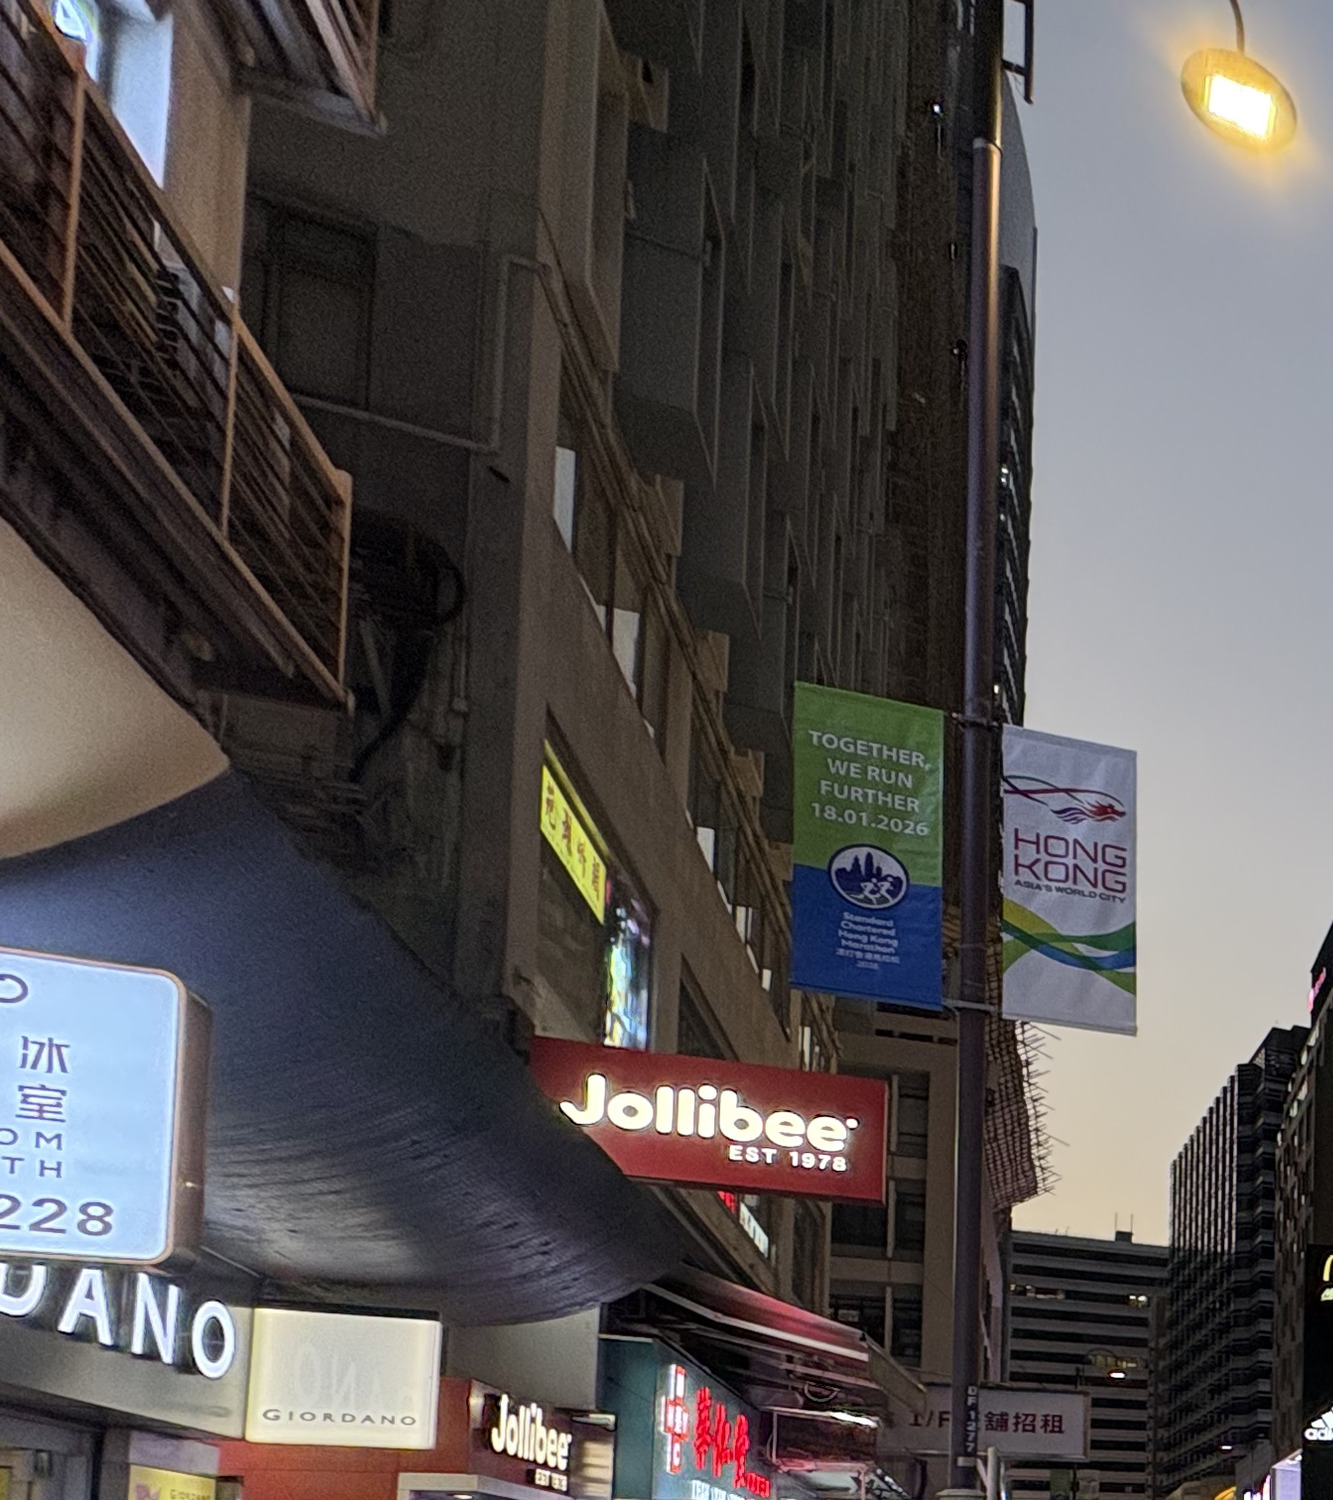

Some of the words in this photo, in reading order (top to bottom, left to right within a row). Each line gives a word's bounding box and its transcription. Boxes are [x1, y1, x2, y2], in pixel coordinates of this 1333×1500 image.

[808, 729, 933, 771] TOGETHER,
[827, 758, 862, 779] WE
[867, 766, 913, 789] RUN
[820, 780, 920, 813] FURTHER
[811, 803, 930, 836] 18.01.2026
[1014, 827, 1128, 869] HONG
[1014, 853, 1128, 894] KONG
[1014, 879, 1053, 893] ASIA'S
[1055, 886, 1098, 899] WORLD
[1098, 892, 1126, 904] CITY
[15, 1035, 71, 1123] 冰室
[558, 1072, 851, 1152] Jollibee
[729, 1145, 778, 1164] EST
[788, 1151, 848, 1172] 1978
[262, 1407, 418, 1428] GIORDANO
[491, 1393, 571, 1472] Jollibee
[978, 1411, 1065, 1434] 舖招租
